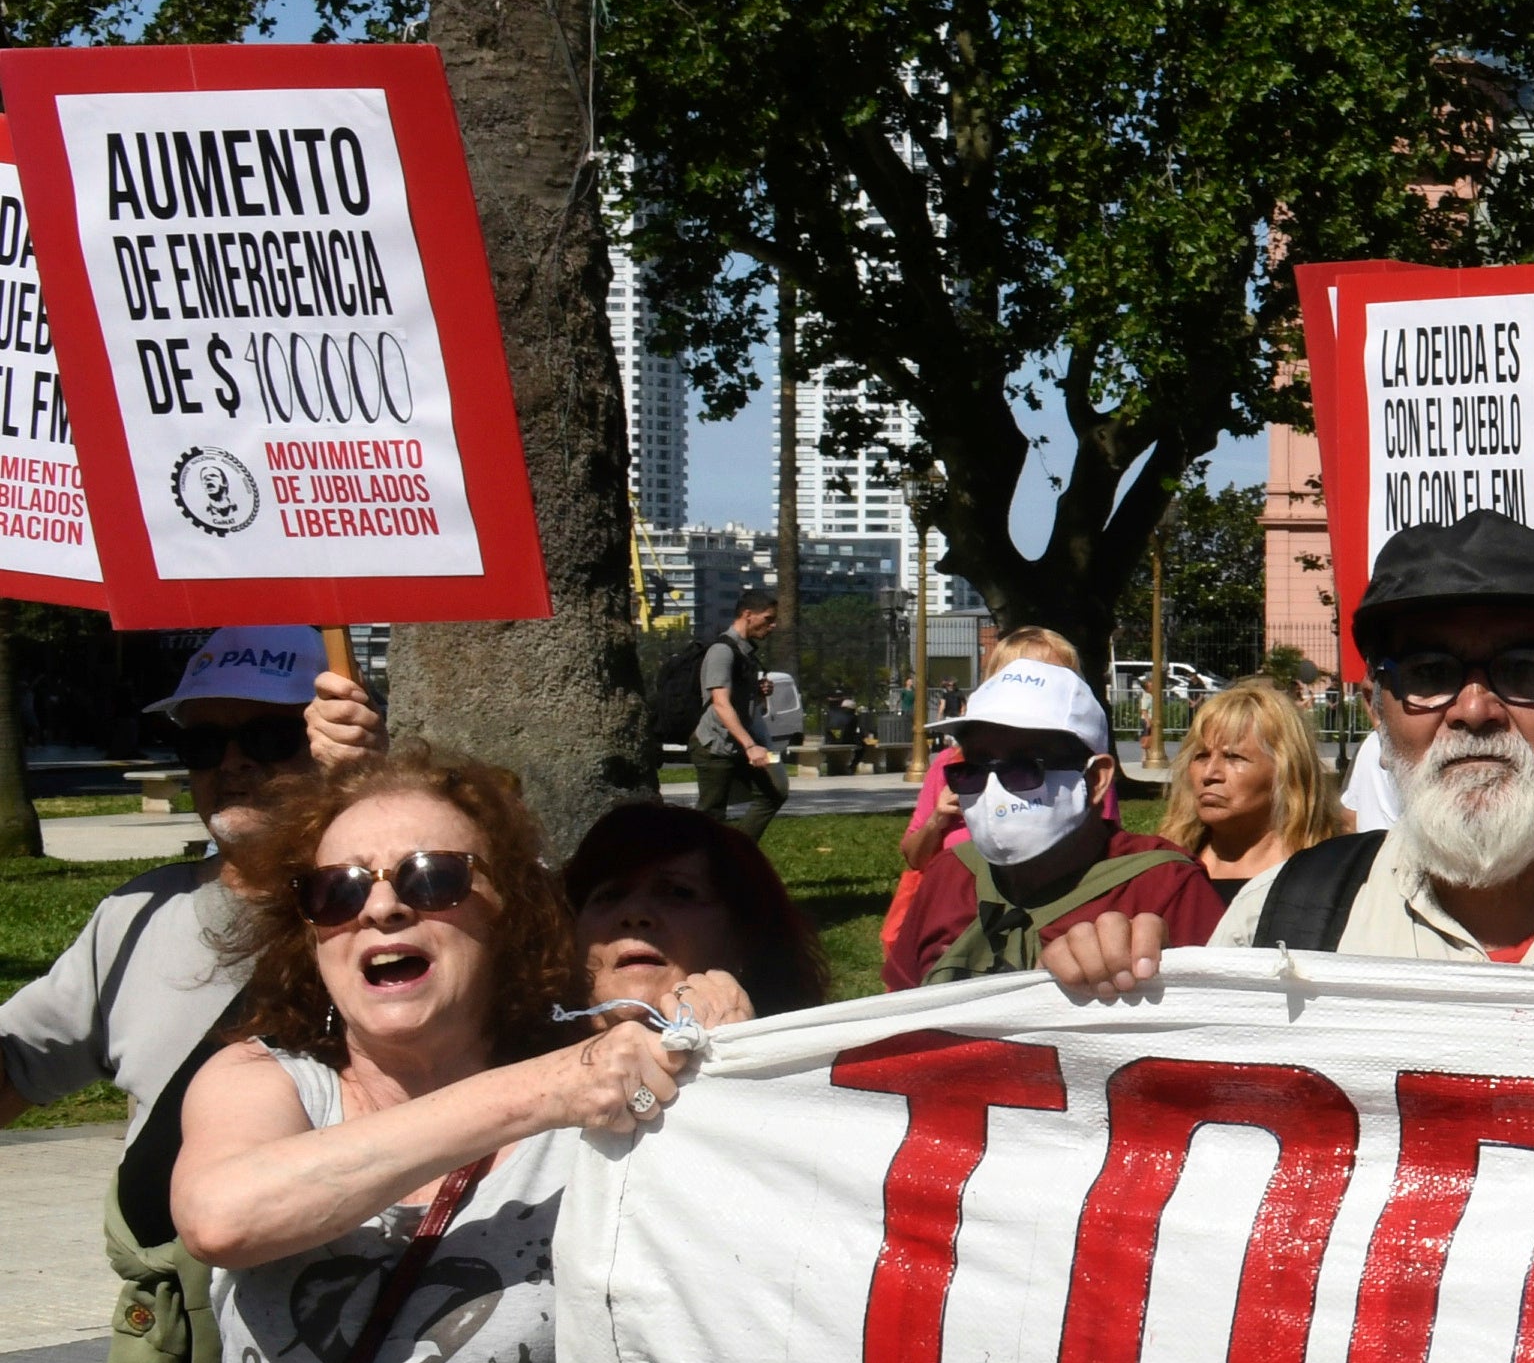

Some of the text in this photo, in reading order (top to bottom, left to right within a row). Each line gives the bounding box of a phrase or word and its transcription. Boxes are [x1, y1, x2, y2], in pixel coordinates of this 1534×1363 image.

[107, 127, 370, 220] AUMENTO
[113, 229, 393, 320] DE EMERGENCIA
[1382, 322, 1520, 387] LA DEUDA ES
[136, 338, 203, 415] DE
[1385, 393, 1521, 458] CON EL PUEBLO
[264, 439, 423, 470] MOVIMIENTO
[0, 455, 83, 490] MIENTO
[272, 476, 309, 504] DE
[310, 474, 430, 504] JUBILADOS
[0, 487, 84, 517] BILADOS
[1387, 471, 1411, 531] NO
[1419, 471, 1458, 528] CON
[0, 512, 83, 545] RACION
[279, 507, 439, 537] LIBERACION
[219, 648, 297, 672] PAMI
[1002, 673, 1046, 687] PAMI
[1011, 797, 1043, 814] PAMI
